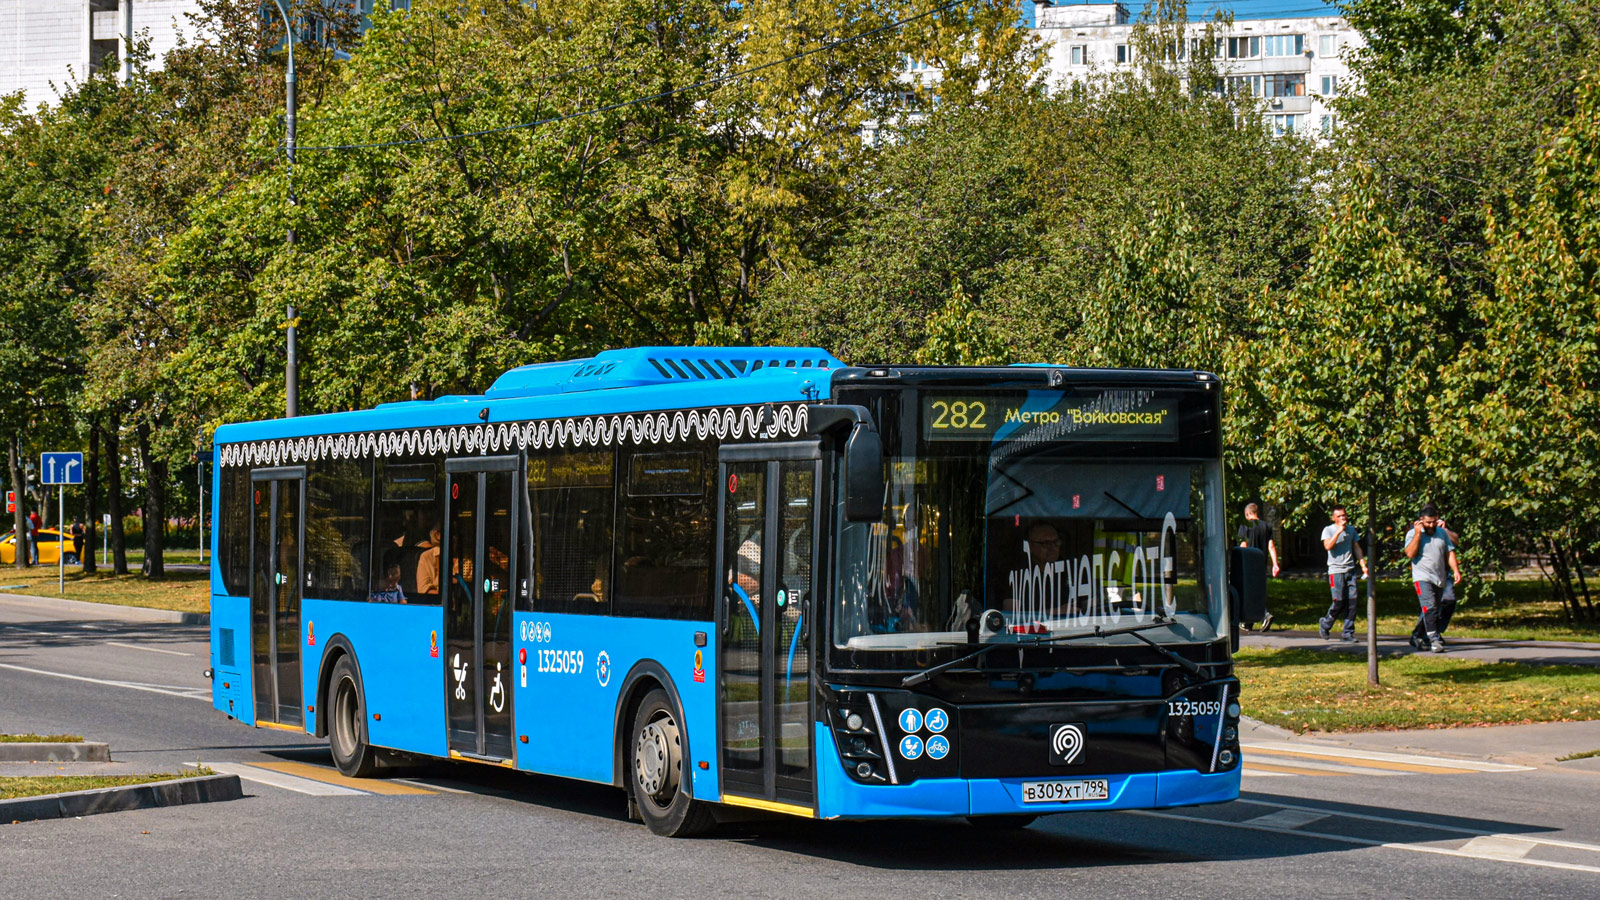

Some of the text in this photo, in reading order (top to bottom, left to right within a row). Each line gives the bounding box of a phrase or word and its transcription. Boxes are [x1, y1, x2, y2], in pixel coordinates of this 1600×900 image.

[931, 400, 1167, 428] 282 Метро "Войковская"
[527, 460, 546, 482] 282
[538, 650, 584, 674] 1325059
[1169, 701, 1220, 716] 1325059
[1084, 781, 1103, 793] 799
